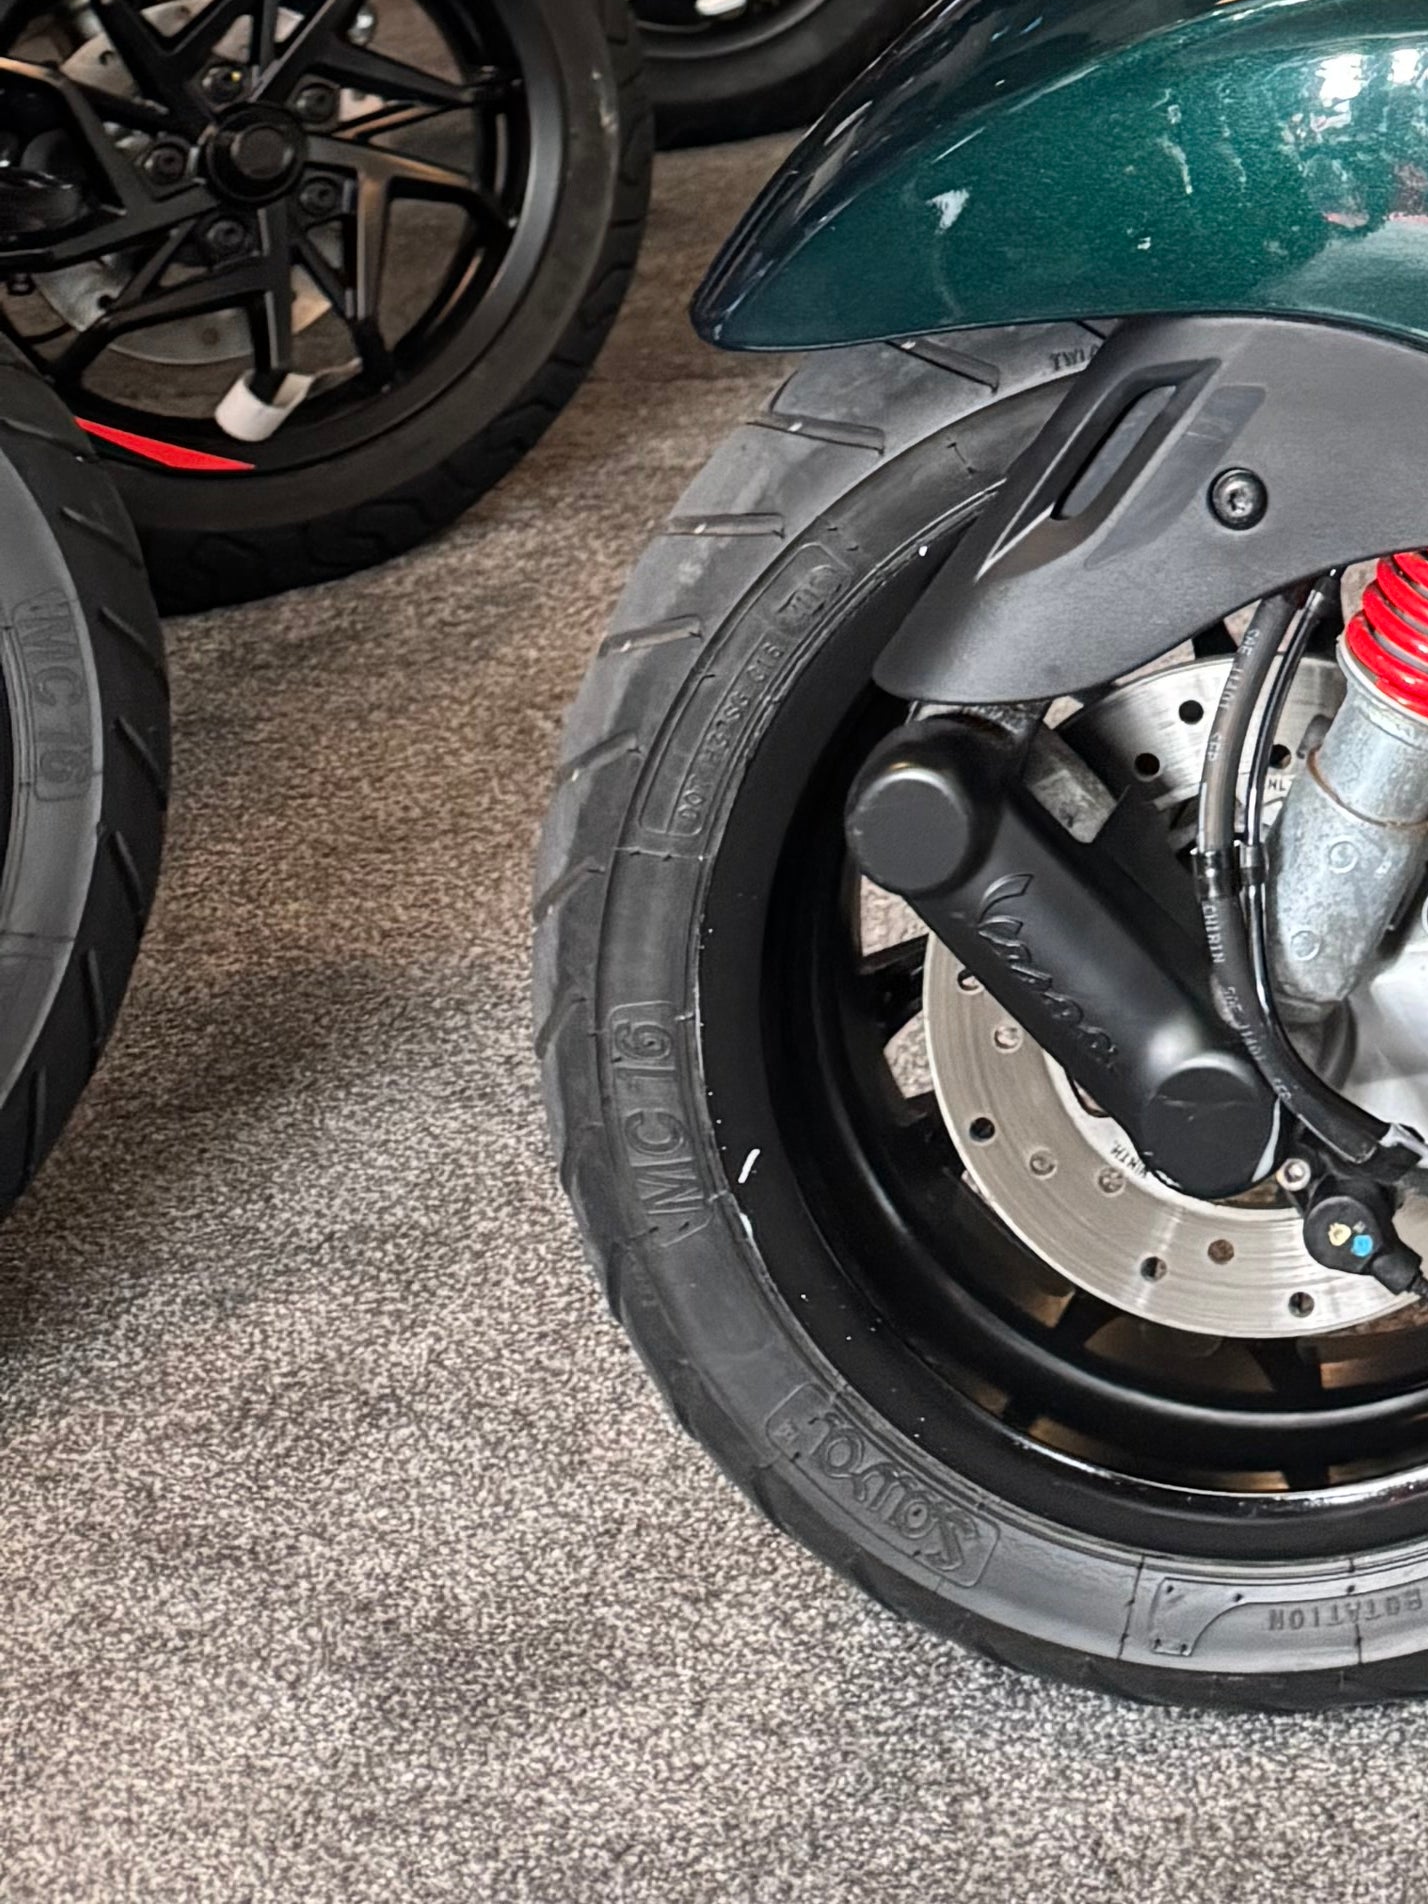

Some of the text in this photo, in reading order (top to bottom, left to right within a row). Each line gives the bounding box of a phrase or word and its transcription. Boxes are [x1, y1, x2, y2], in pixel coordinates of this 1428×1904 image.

[977, 873, 1118, 1072] Vespa
[612, 1019, 705, 1214] MC 16
[810, 1412, 980, 1572] Sava
[1268, 1588, 1423, 1631] ROTATION
